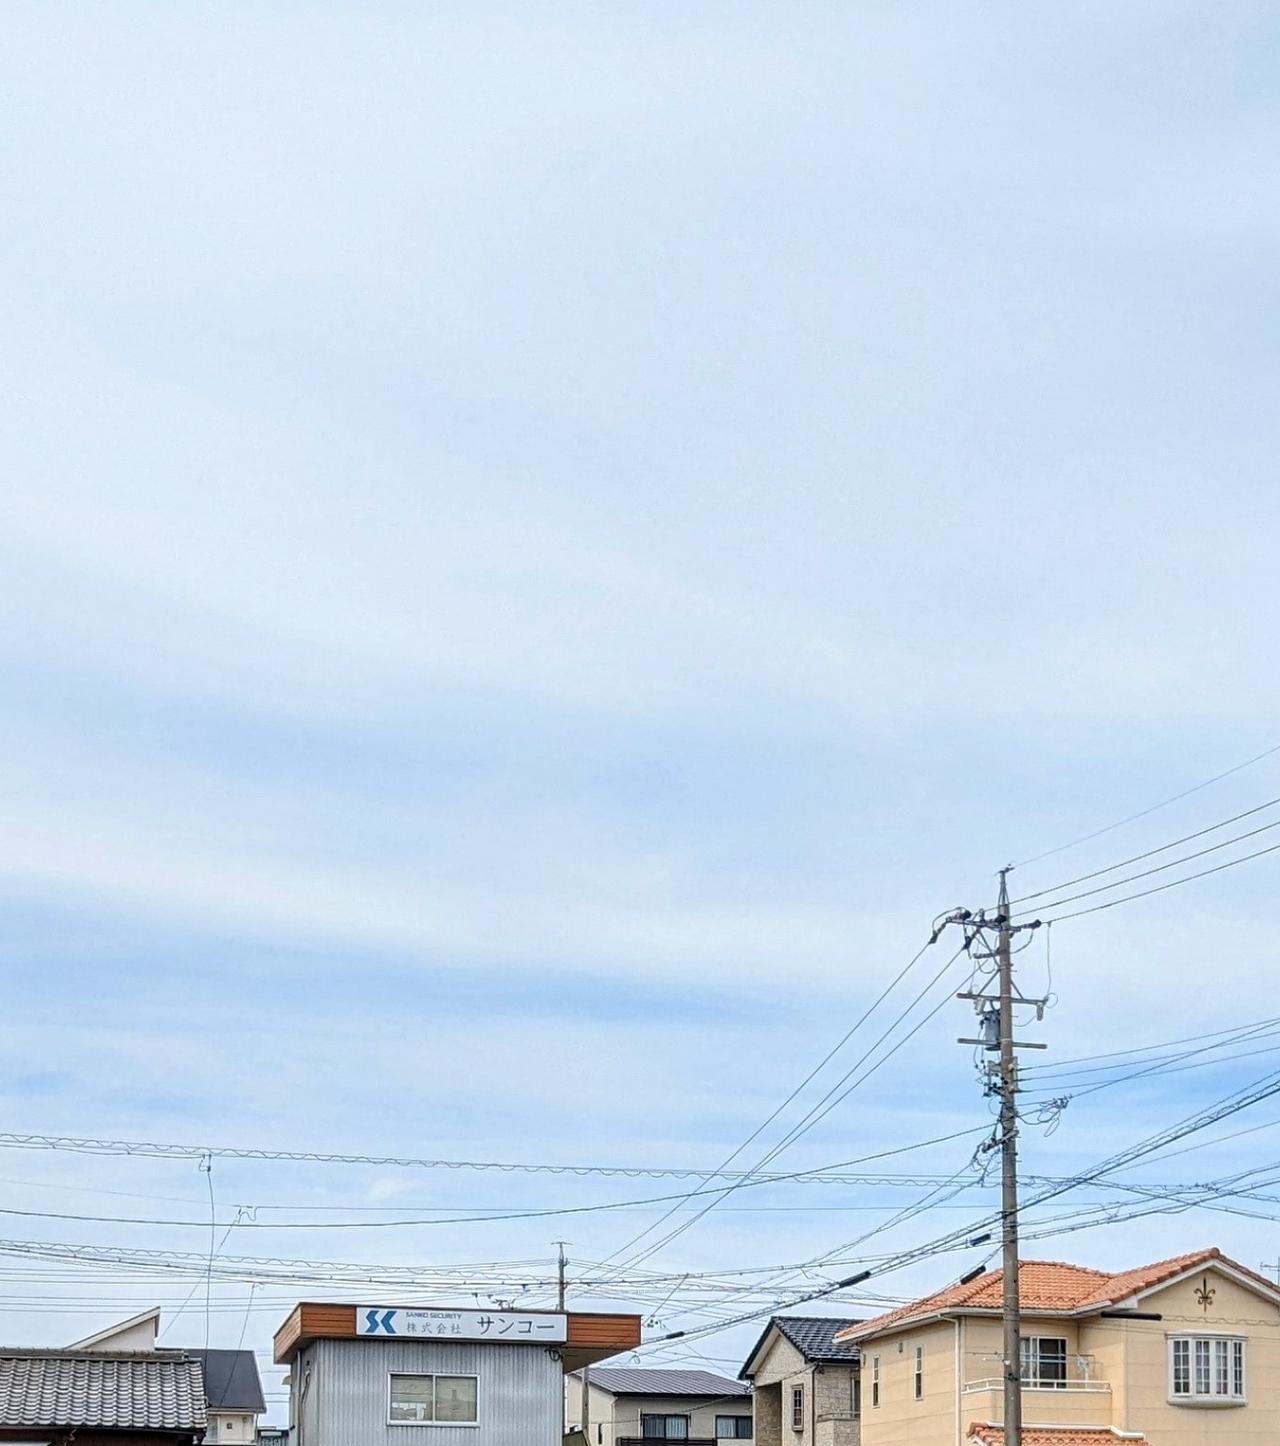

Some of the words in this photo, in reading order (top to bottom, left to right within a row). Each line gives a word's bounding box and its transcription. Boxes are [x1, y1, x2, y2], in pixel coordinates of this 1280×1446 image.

[407, 1322, 462, 1335] 株式会社
[477, 1316, 554, 1335] サンコー
